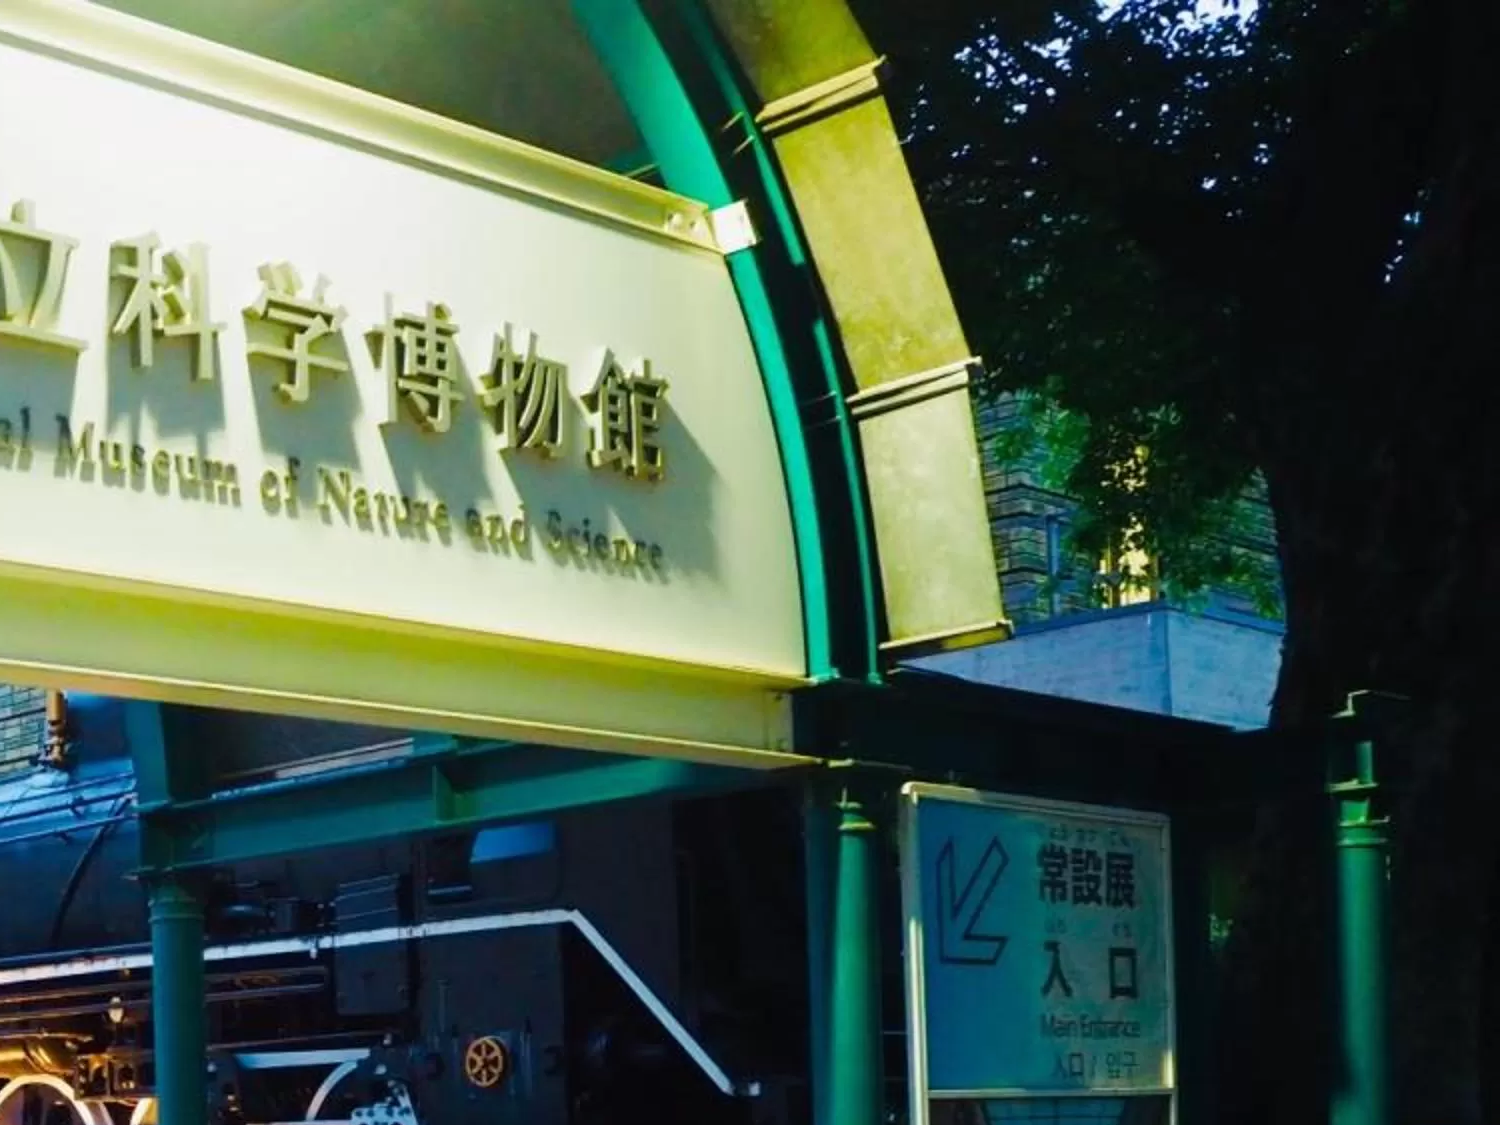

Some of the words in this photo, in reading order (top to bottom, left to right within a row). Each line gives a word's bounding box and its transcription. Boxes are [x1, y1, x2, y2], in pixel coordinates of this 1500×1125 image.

[54, 412, 241, 490] Museum
[259, 456, 299, 507] of
[316, 465, 451, 535] Nature
[465, 504, 532, 549] and
[544, 510, 666, 573] Science
[1036, 842, 1138, 909] 常設展
[1040, 940, 1139, 1000] 入口
[1039, 1012, 1078, 1038] Main
